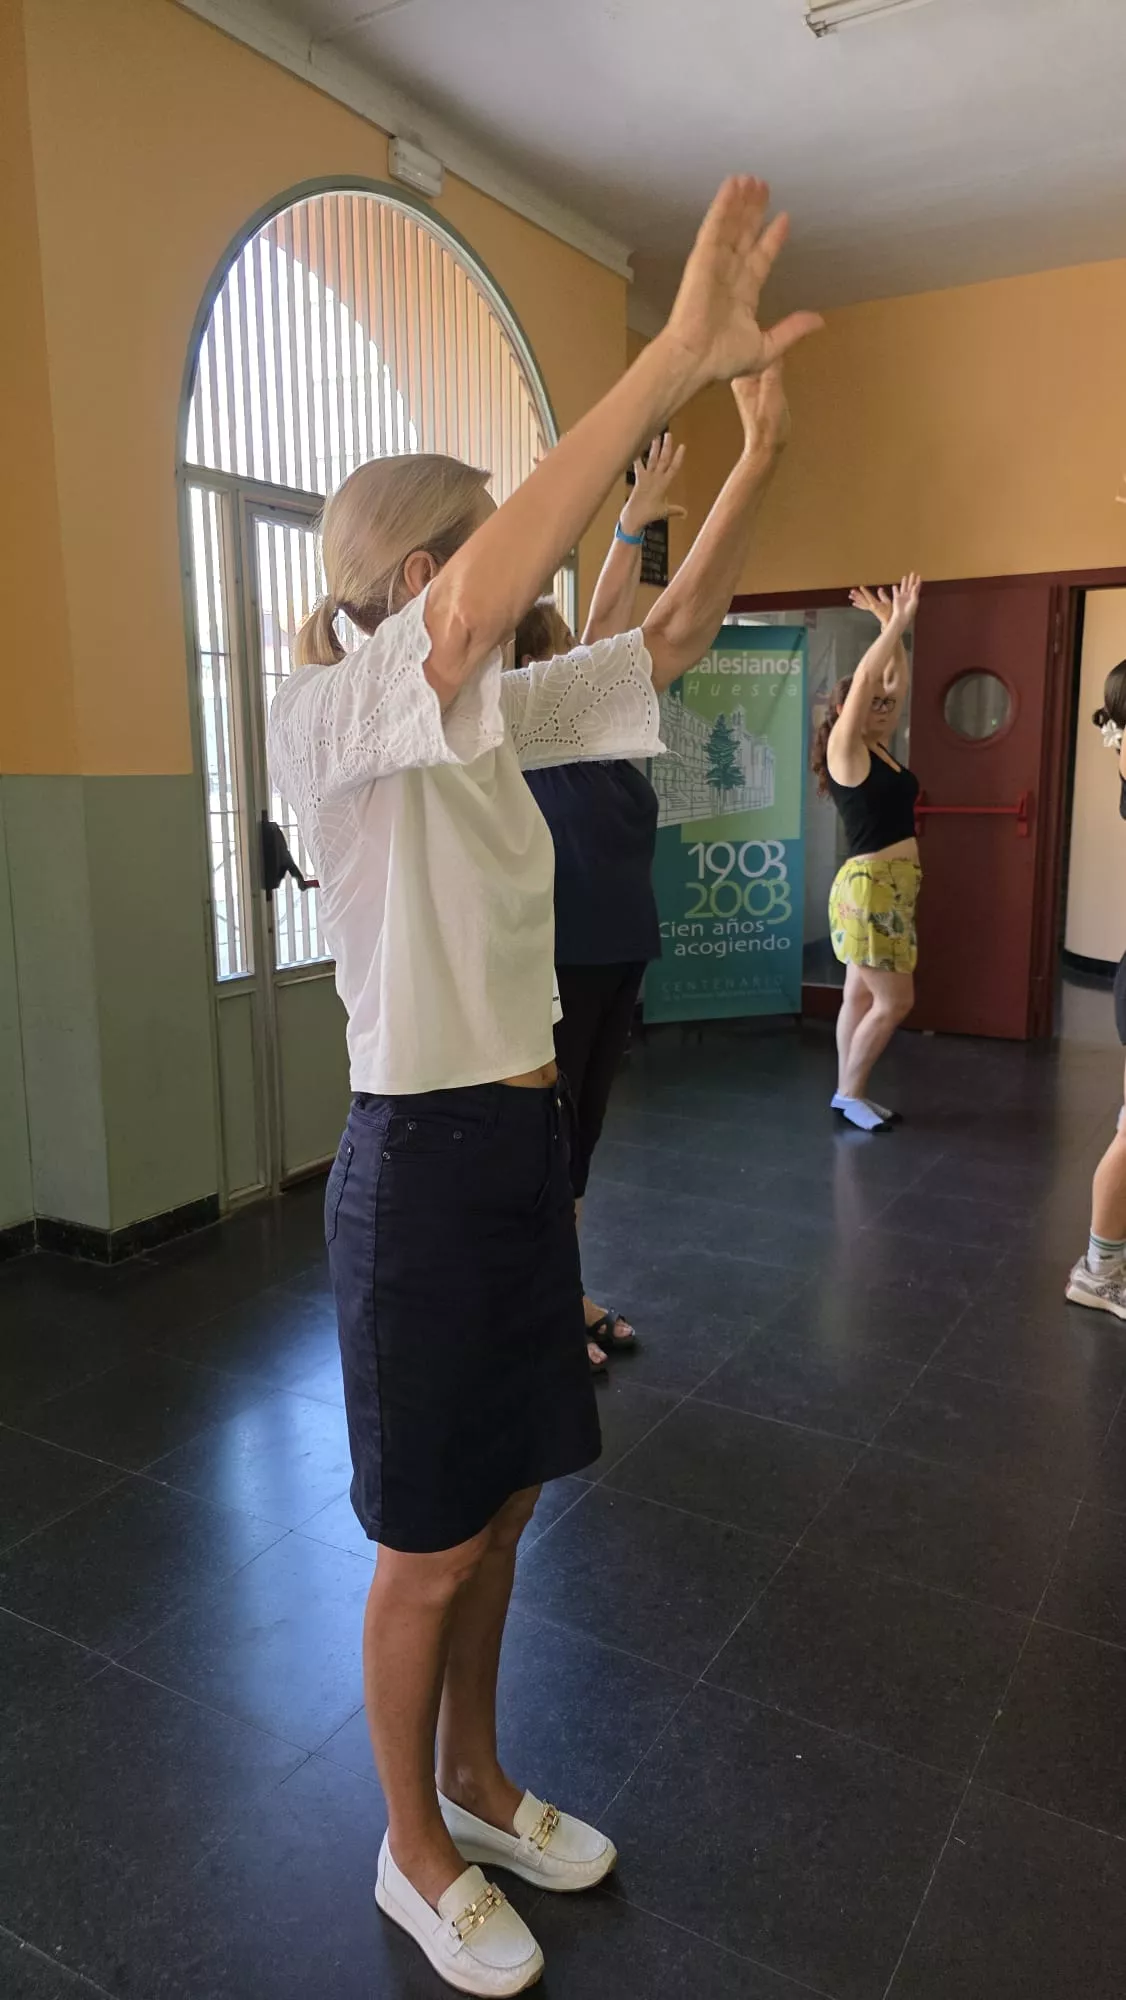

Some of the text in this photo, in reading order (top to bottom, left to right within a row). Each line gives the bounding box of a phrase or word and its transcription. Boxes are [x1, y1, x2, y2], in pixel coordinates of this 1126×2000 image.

[687, 681, 798, 696] Huesca
[688, 840, 787, 888] 1903
[684, 879, 792, 924] 2003
[659, 918, 765, 938] Cien años
[674, 934, 791, 958] acogiendo
[661, 974, 783, 992] CENTENARIO
